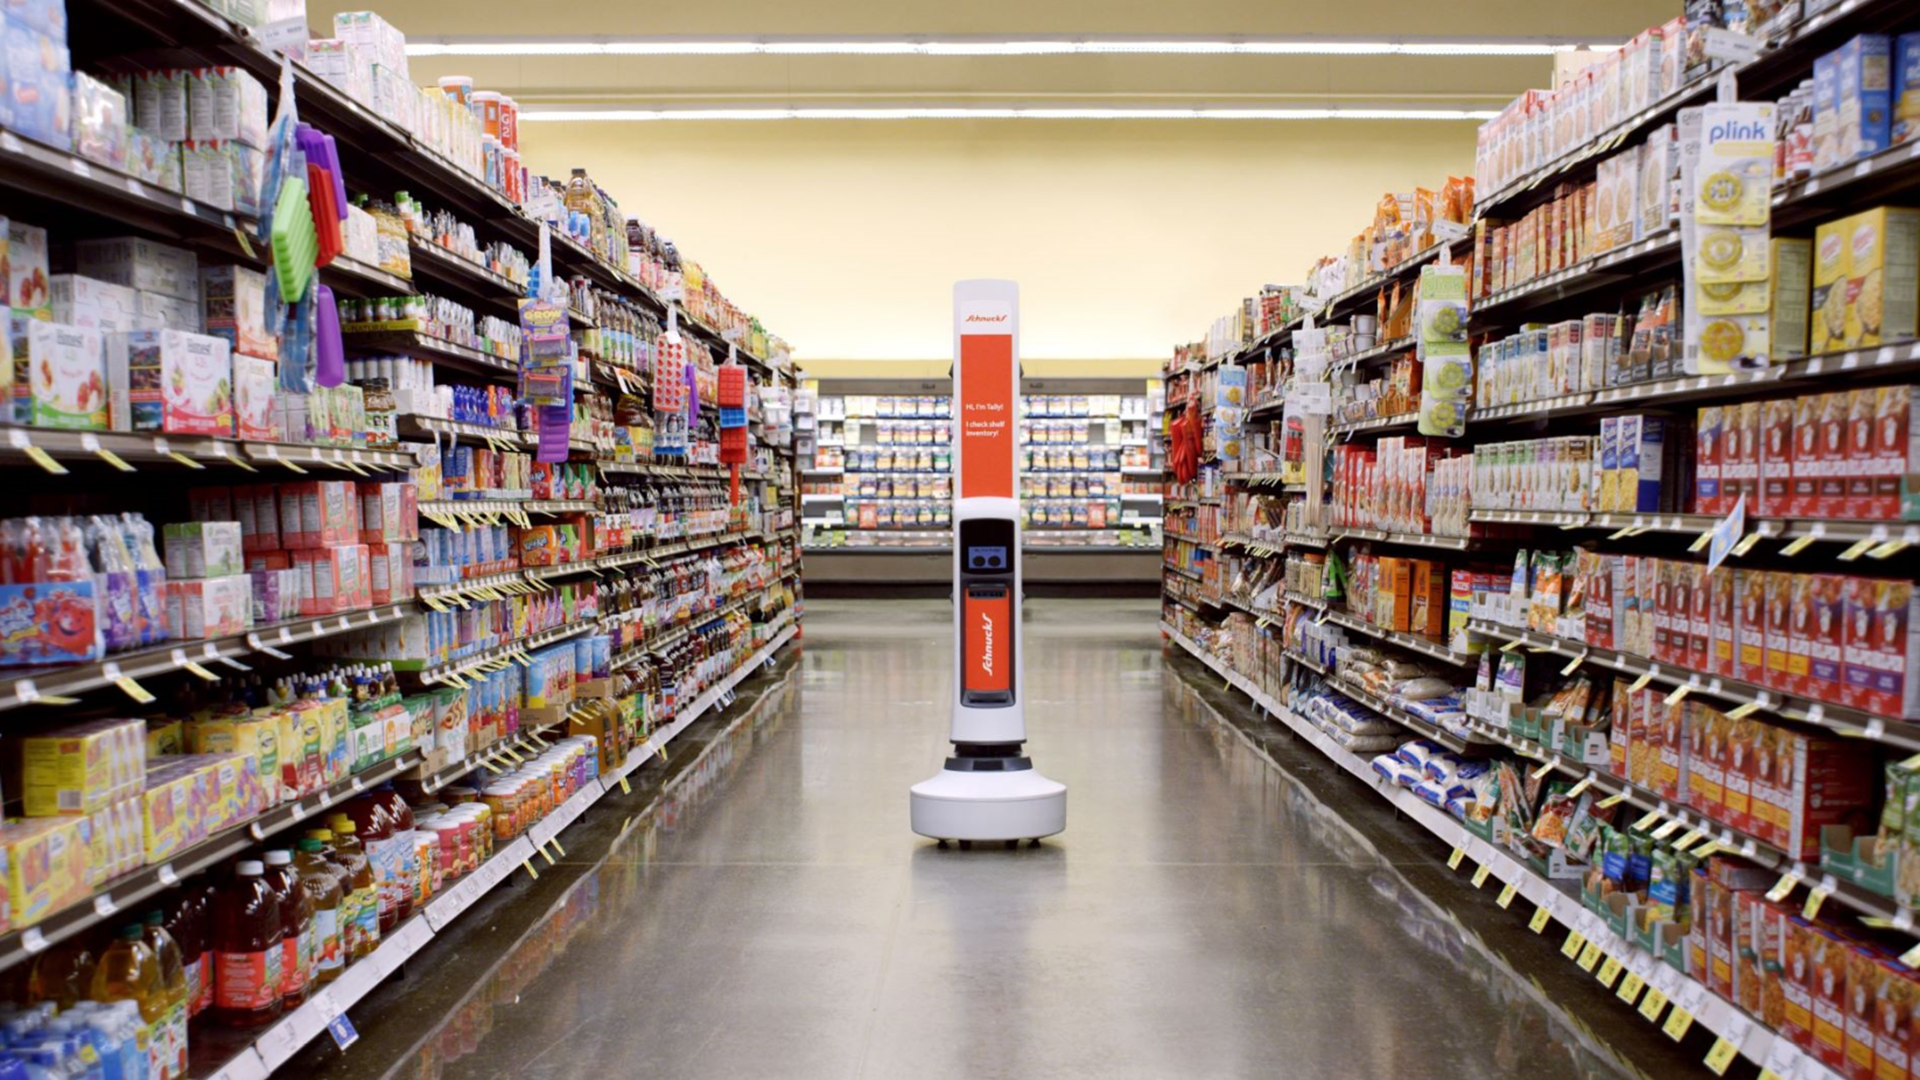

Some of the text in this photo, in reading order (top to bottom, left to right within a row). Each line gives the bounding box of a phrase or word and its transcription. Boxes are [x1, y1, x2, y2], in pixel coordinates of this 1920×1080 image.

[1709, 121, 1765, 144] plink
[965, 314, 1007, 322] Schnucks
[966, 403, 1004, 413] Hi, I'm Tally!
[966, 430, 999, 438] inventory!
[982, 612, 993, 676] Schnucks
